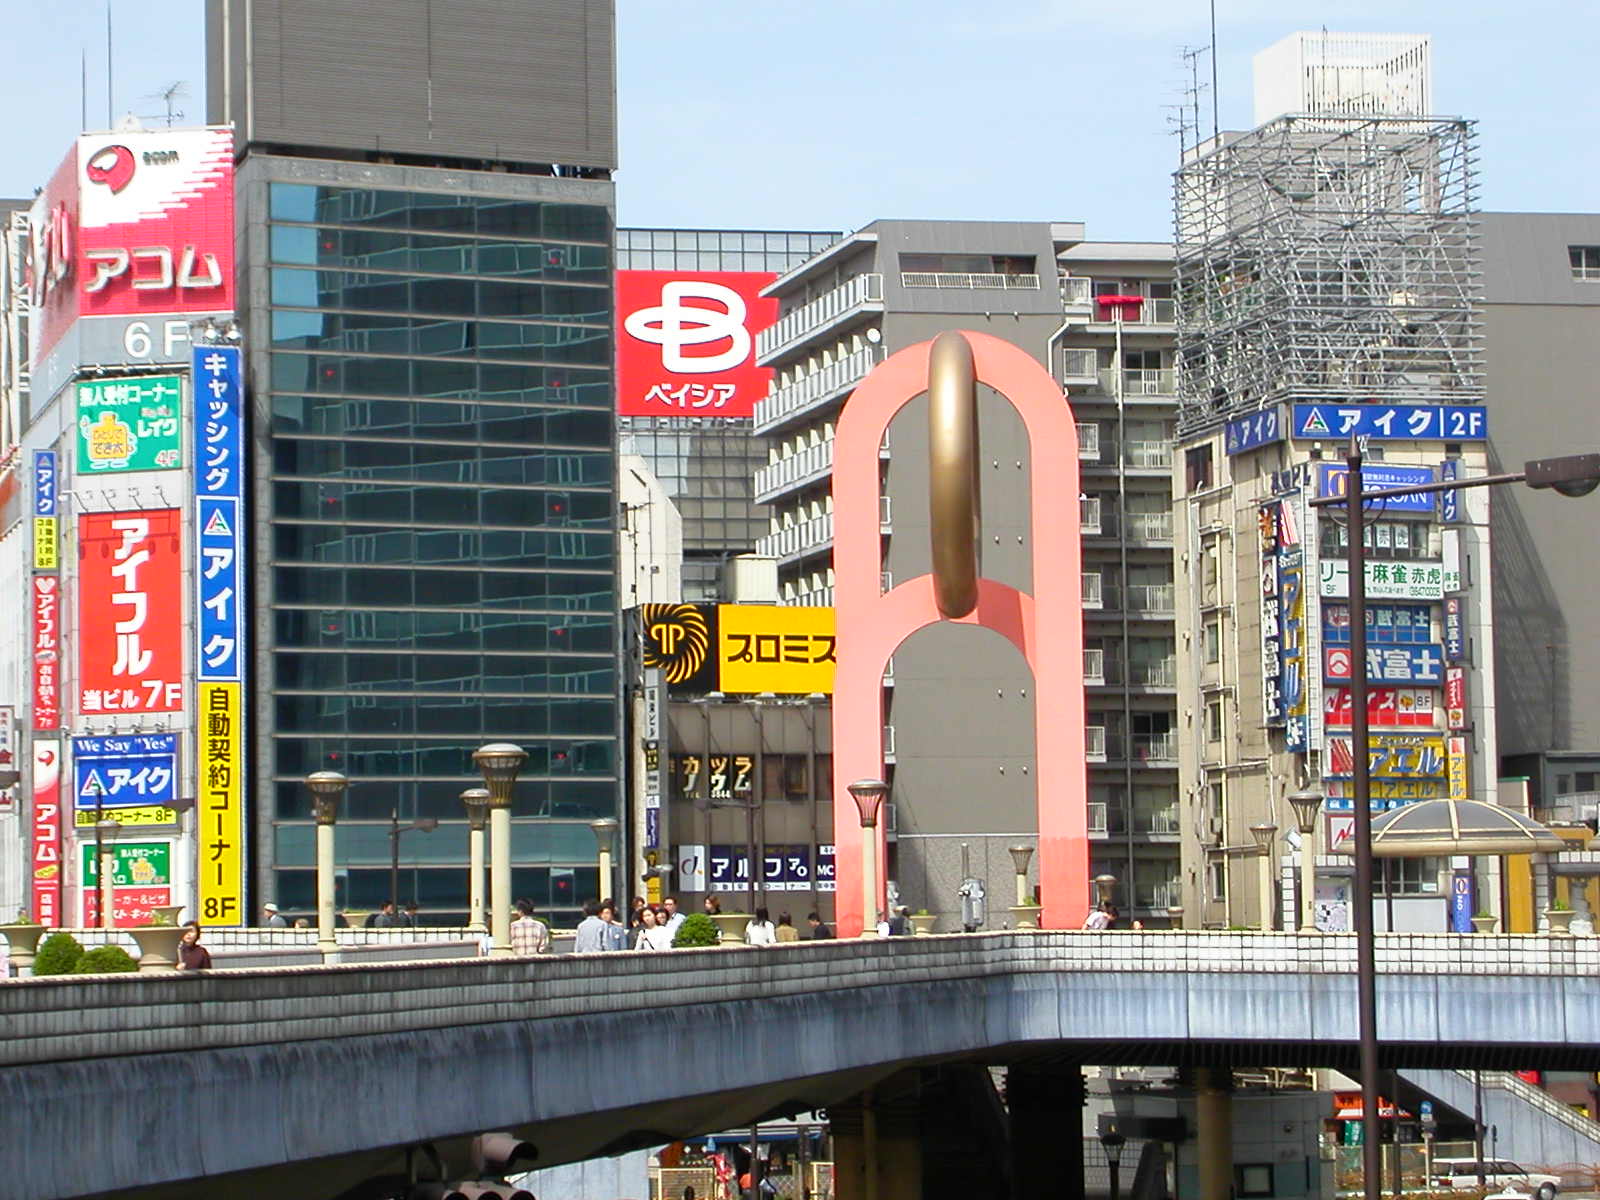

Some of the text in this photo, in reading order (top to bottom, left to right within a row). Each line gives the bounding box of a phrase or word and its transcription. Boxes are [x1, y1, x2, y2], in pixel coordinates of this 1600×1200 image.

[84, 245, 222, 292] アコム
[644, 383, 736, 408] ベイシア
[137, 418, 177, 437] レイク
[204, 353, 230, 492] キャッシング
[1241, 411, 1276, 446] アイク
[1338, 408, 1482, 436] アイク 2F
[37, 469, 53, 512] アイク
[111, 518, 153, 675] アイフル
[203, 547, 235, 669] アイク
[37, 594, 55, 648] アイフル
[727, 633, 836, 663] プロミス
[77, 740, 100, 752] We
[104, 739, 131, 753] Say
[1368, 746, 1444, 774] アエル
[682, 756, 753, 774] カツラ
[107, 766, 171, 795] アイク
[207, 687, 231, 886] 自動契約コーナー
[155, 809, 173, 822] 8F
[36, 804, 56, 861] アコム
[204, 897, 236, 919] 8F
